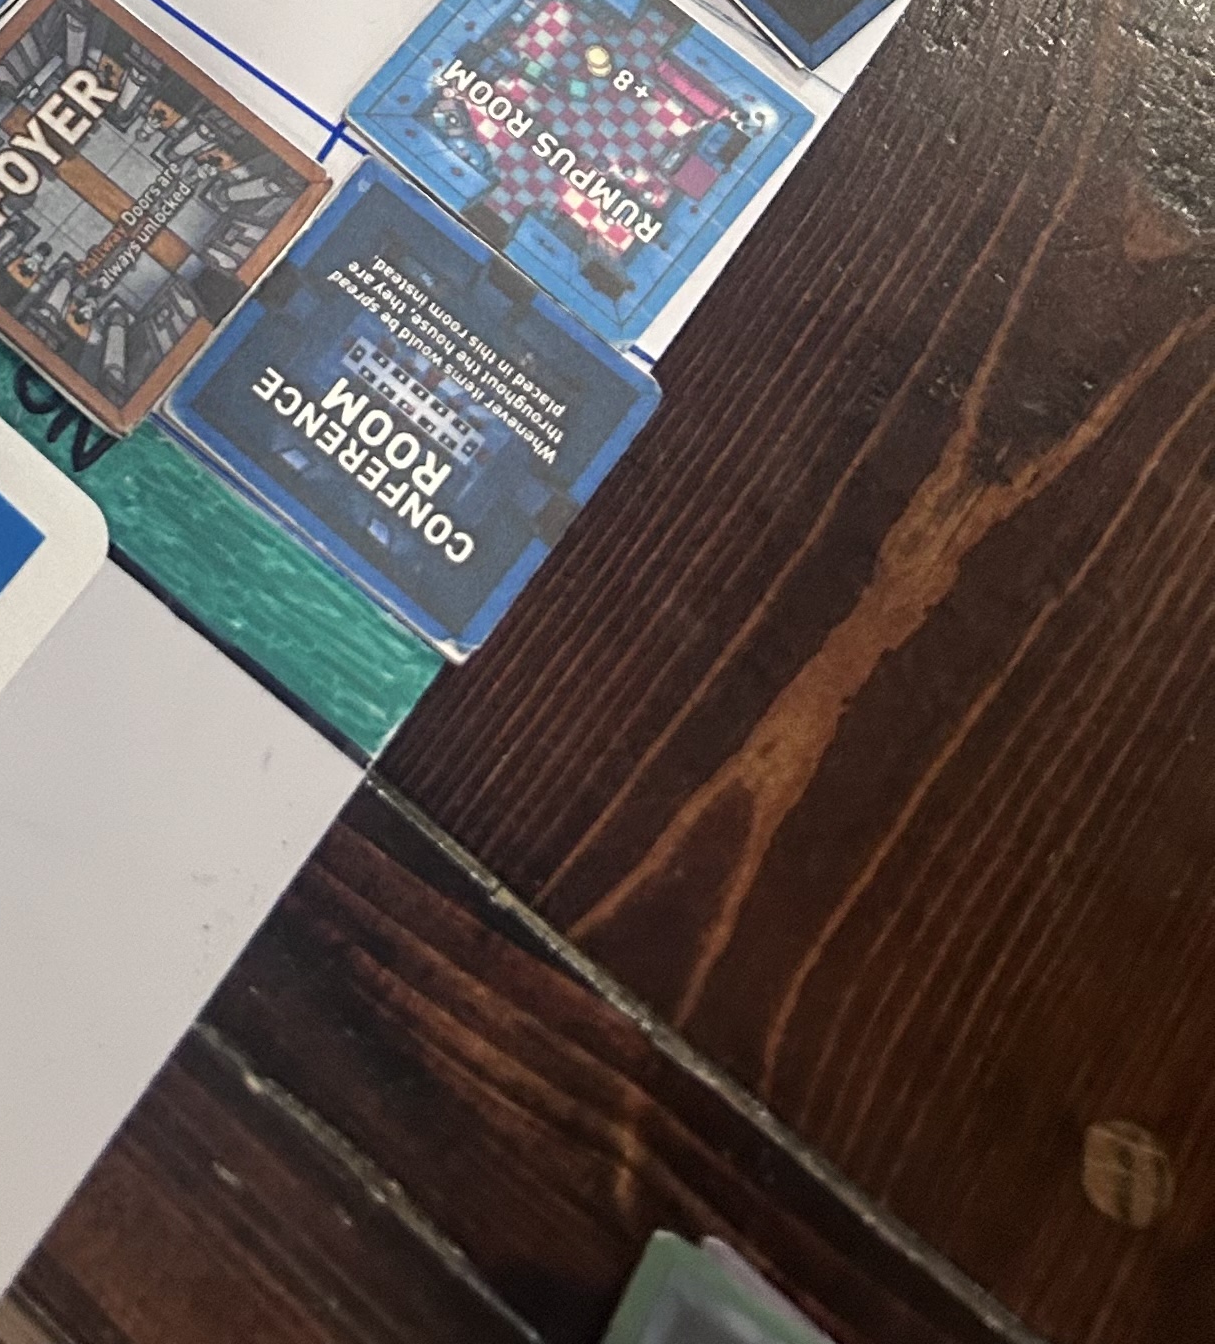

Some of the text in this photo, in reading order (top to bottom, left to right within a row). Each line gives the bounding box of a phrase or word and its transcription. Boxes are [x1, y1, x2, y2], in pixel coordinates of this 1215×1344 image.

[441, 58, 662, 244] RUMPUS ROOM
[120, 184, 161, 226] Doors
[157, 162, 180, 188] are
[99, 240, 141, 289] always
[348, 261, 375, 285] are
[373, 282, 407, 314] they
[326, 270, 557, 465] Whenever items would be spread
[372, 255, 567, 418] placed in this room instead.
[455, 350, 481, 376] the
[321, 378, 452, 498] ROOM
[484, 372, 564, 444] throughout
[252, 366, 475, 564] CONFERENCE
